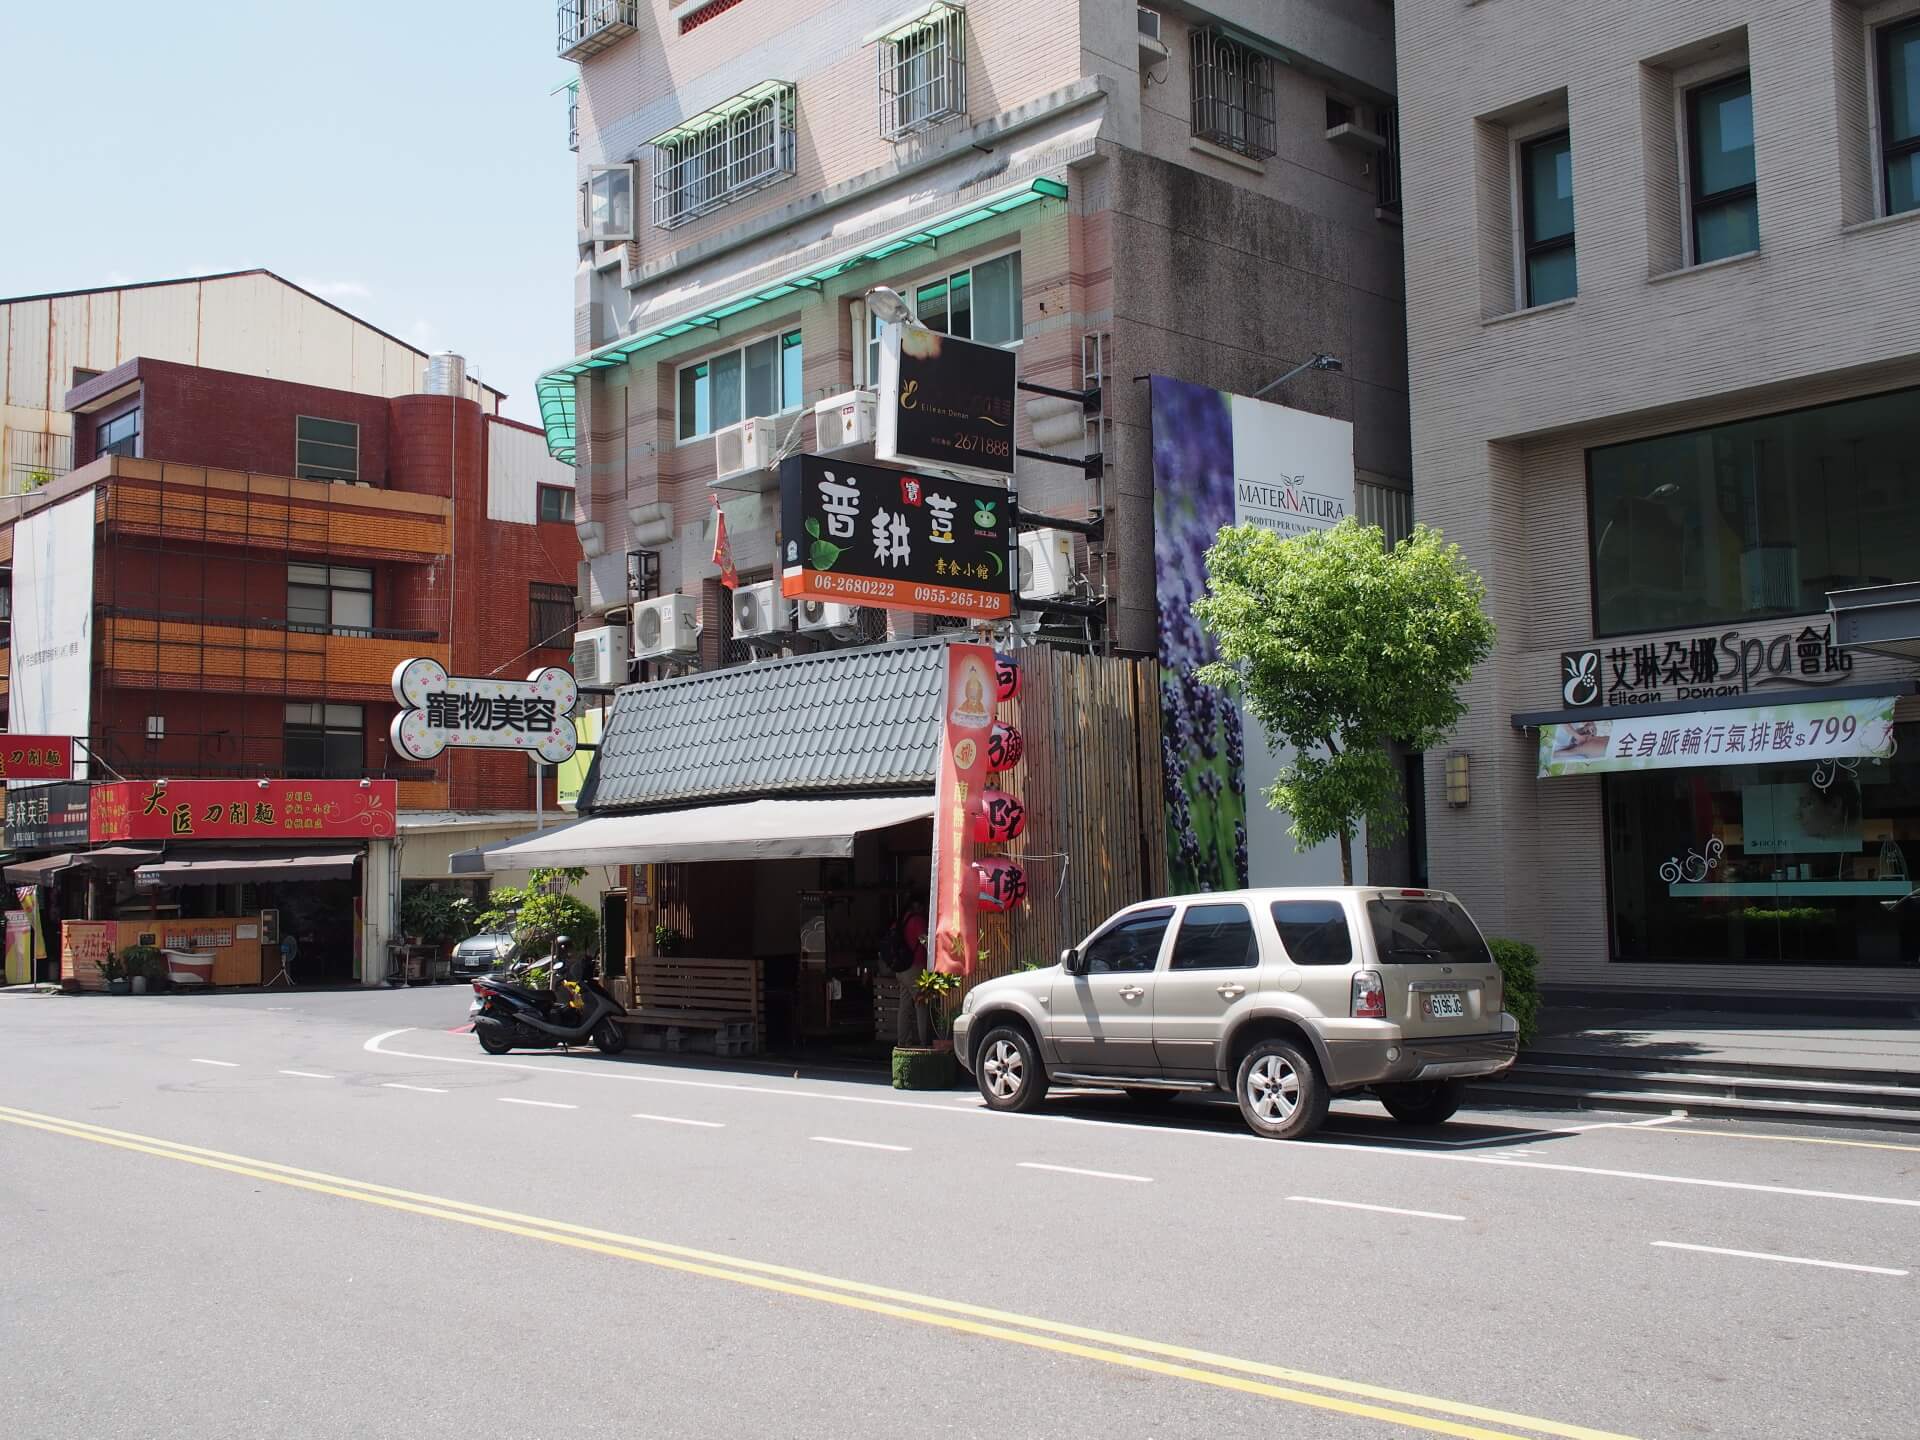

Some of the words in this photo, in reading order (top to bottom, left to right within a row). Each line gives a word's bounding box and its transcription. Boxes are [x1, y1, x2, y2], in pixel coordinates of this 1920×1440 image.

[954, 432, 1009, 457] 2671888
[1239, 484, 1345, 520] MATERNATURA
[935, 557, 990, 580] 素食小館
[814, 574, 896, 597] 06-2680222
[914, 586, 1001, 610] 0955-265-128
[1677, 684, 1740, 701] Donan
[426, 691, 557, 732] 寵物美容
[0, 748, 63, 777] 刀削麵
[144, 783, 277, 836] 大匠刀削麵
